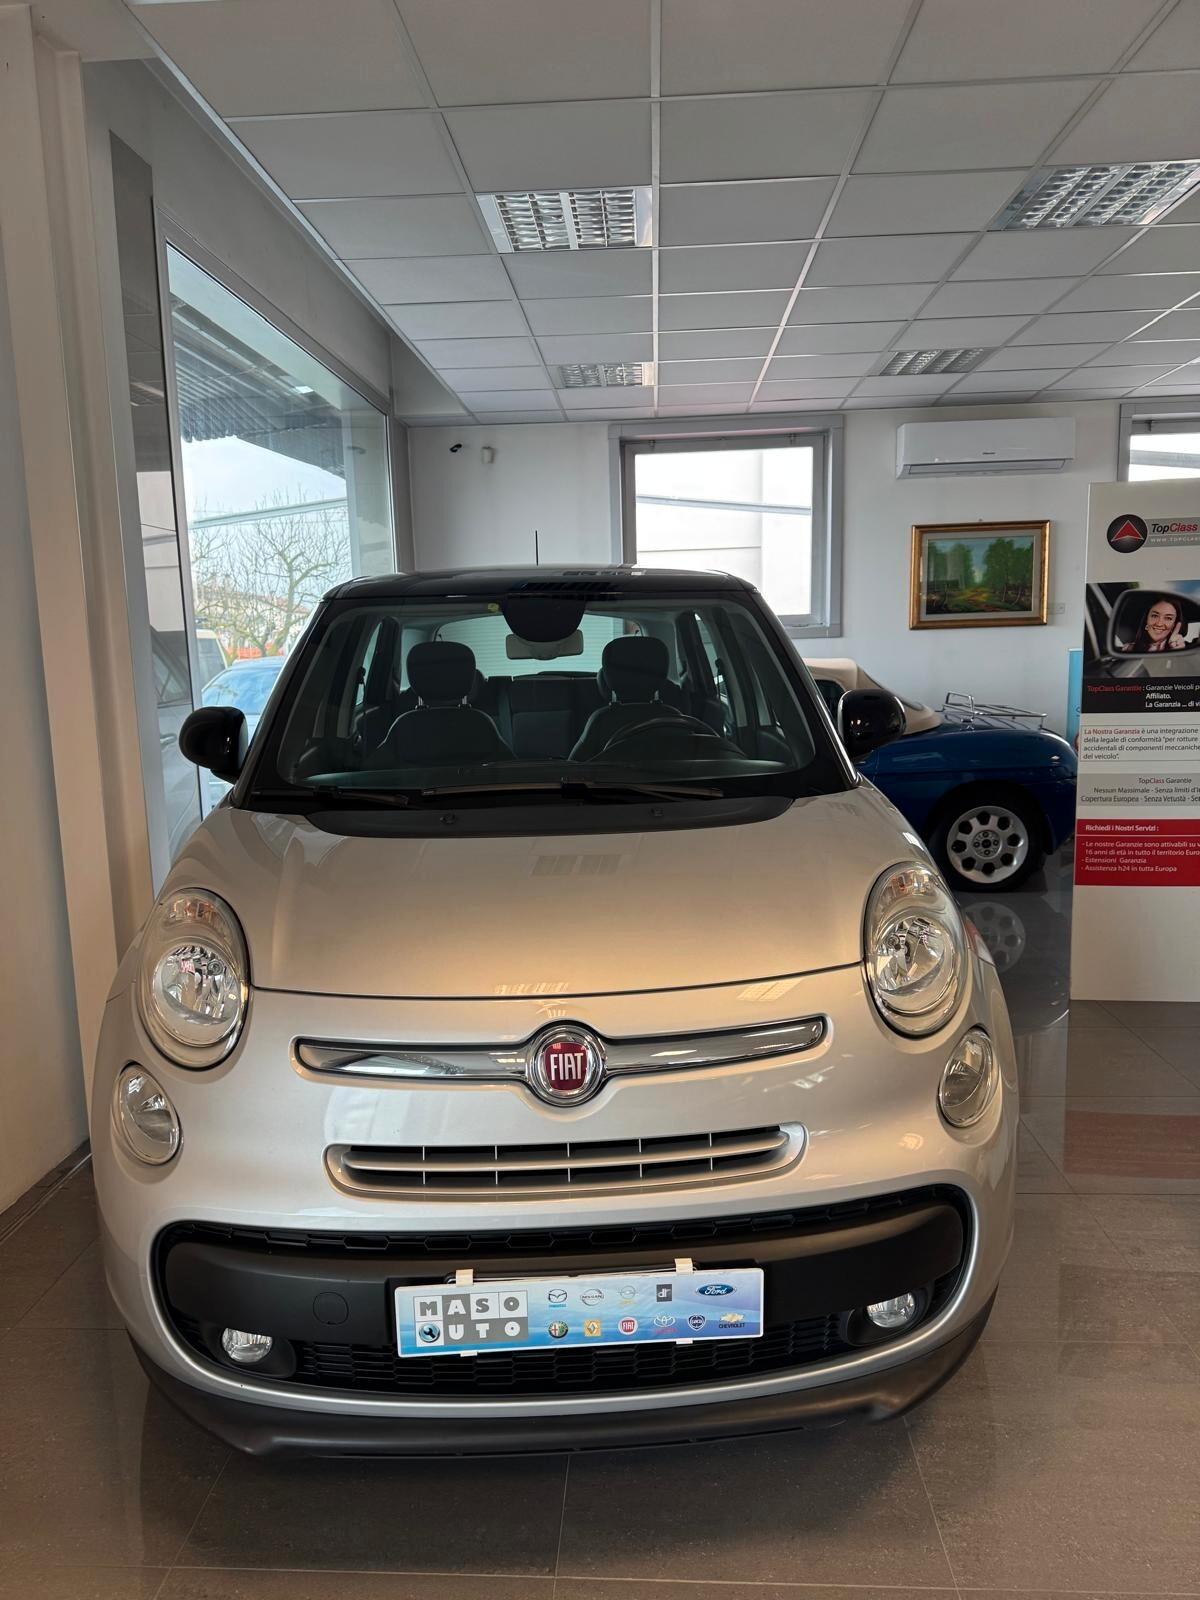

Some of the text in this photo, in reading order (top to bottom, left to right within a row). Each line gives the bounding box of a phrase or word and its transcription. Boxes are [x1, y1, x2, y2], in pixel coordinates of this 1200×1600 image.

[1151, 522, 1198, 534] TopClass
[550, 1052, 584, 1080] FIAT
[705, 1286, 728, 1296] Ford
[420, 1296, 520, 1316] MASO
[623, 1321, 634, 1330] FIAT
